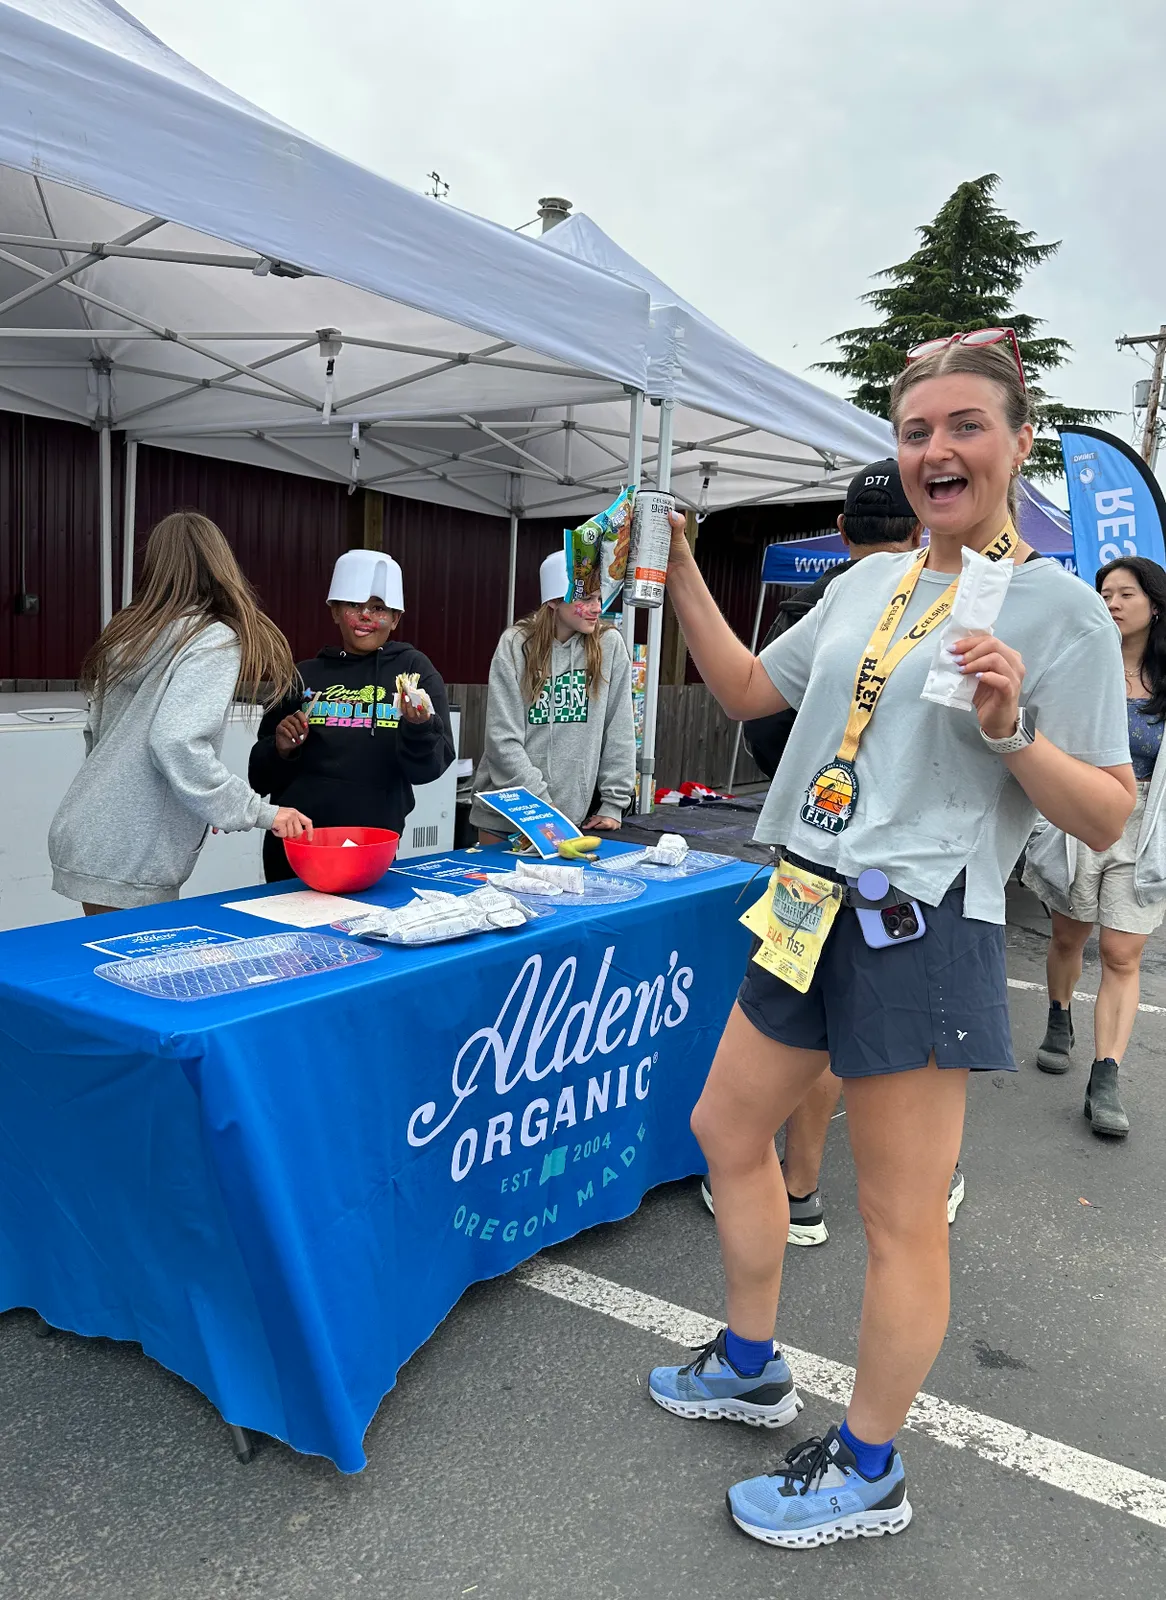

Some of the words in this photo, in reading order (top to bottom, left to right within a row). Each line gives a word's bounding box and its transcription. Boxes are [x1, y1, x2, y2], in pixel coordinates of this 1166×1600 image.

[864, 475, 890, 487] DT1
[985, 532, 1013, 562] ALF
[883, 605, 900, 631] CELSIUS
[920, 602, 949, 628] CELSIUS
[535, 687, 587, 710] RUN
[858, 675, 886, 713] 13.1
[806, 808, 838, 830] FLAT
[785, 937, 805, 957] 1152
[407, 945, 694, 1147] Alden's
[450, 1055, 653, 1183] ORGANIC
[500, 1167, 532, 1194] EST
[572, 1131, 612, 1164] 2004
[453, 1203, 558, 1243] OREGON
[576, 1121, 646, 1208] MADE
